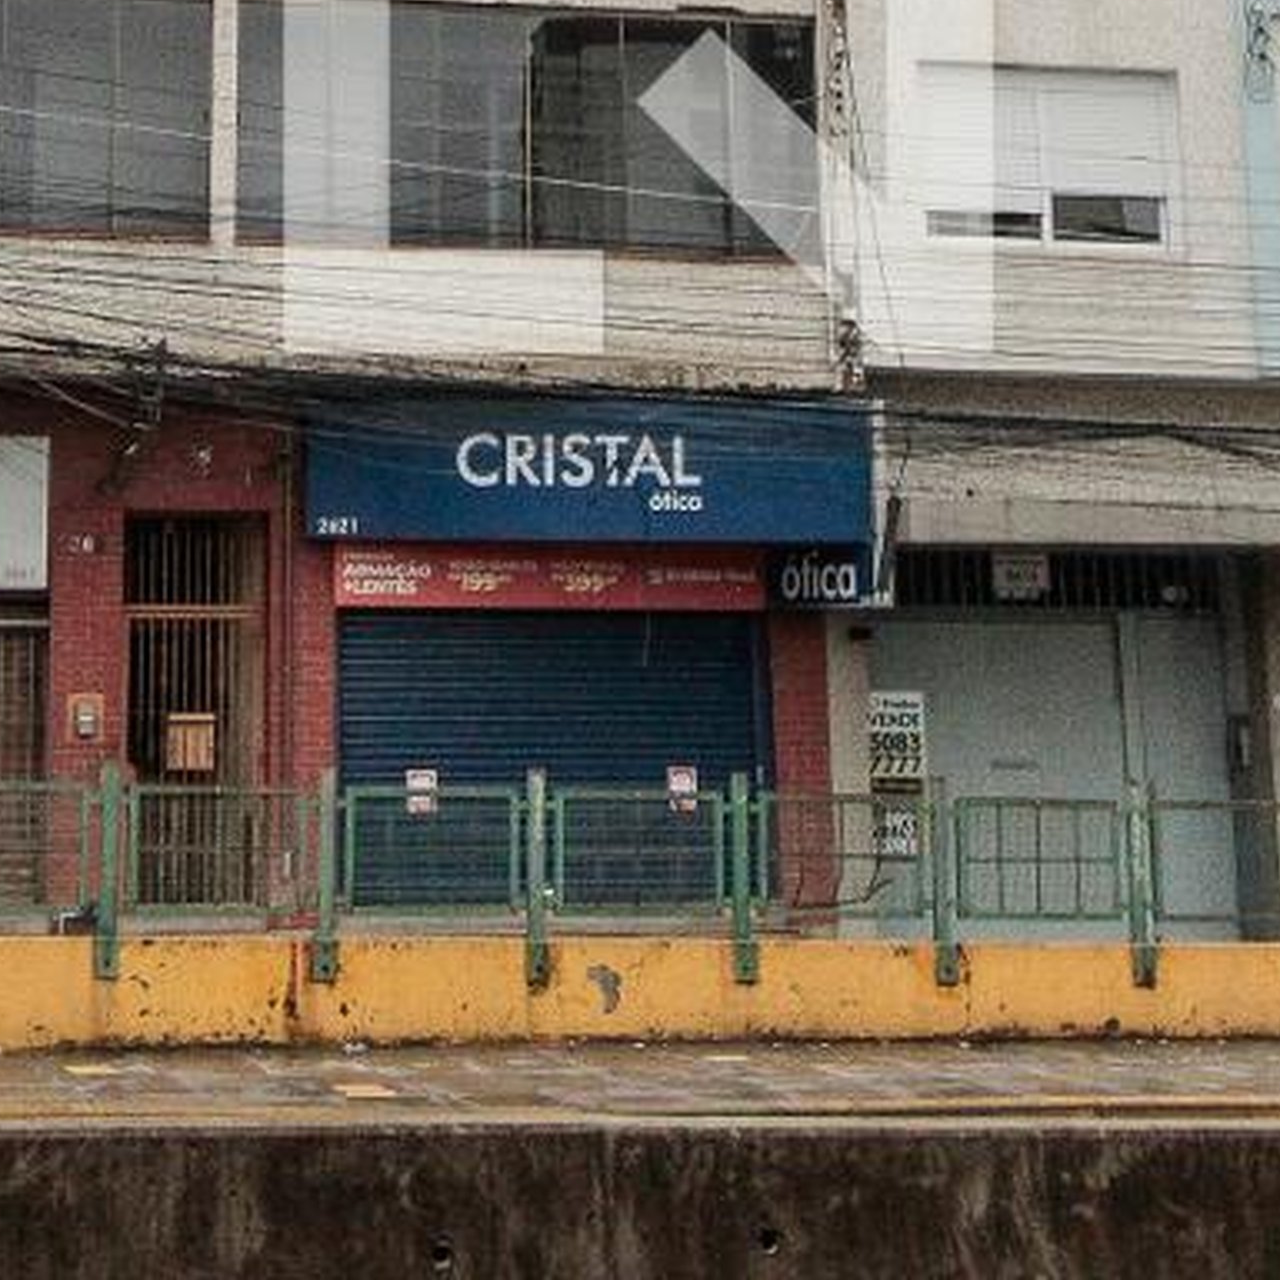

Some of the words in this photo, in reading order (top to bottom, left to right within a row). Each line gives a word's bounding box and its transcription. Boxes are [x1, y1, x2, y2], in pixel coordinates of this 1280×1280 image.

[456, 431, 703, 488] CRISTAL
[648, 488, 703, 512] ótica
[781, 550, 857, 600] ótica
